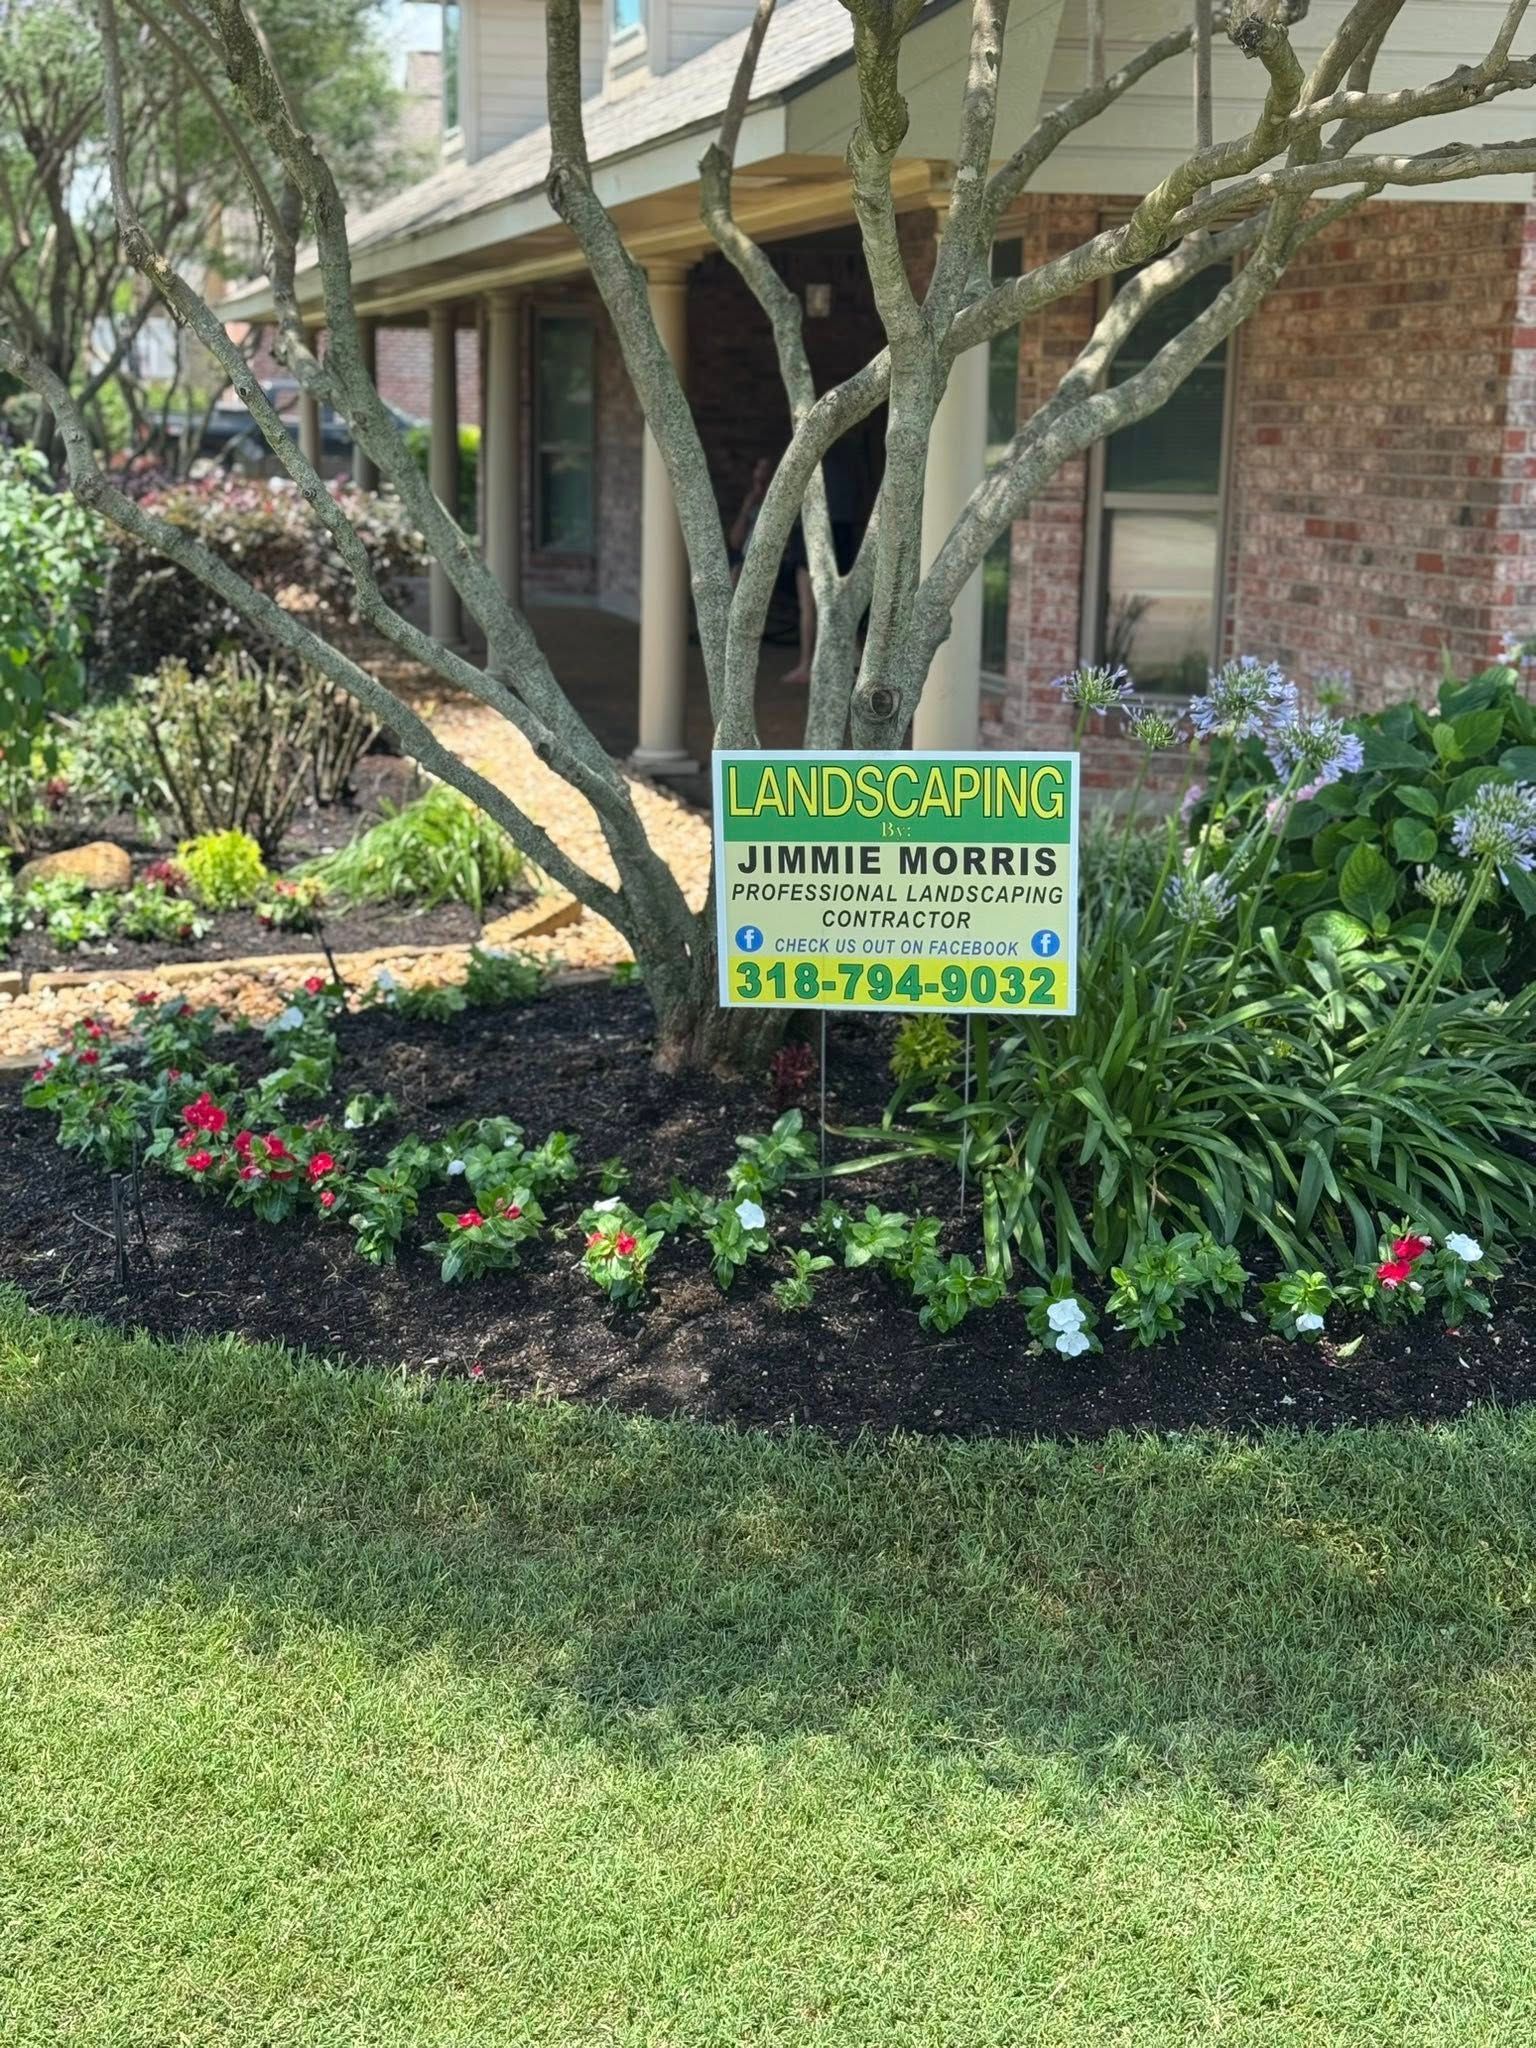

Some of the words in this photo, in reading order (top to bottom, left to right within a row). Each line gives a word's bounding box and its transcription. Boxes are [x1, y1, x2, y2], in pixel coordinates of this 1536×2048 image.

[727, 765, 1065, 819] LANDSCAPING
[881, 821, 912, 840] By:
[737, 845, 881, 875] JIMMIE
[900, 846, 1057, 877] MORRIS
[732, 883, 898, 902] PROFESSIONAL
[907, 884, 1063, 904] LANDSCAPING
[822, 910, 971, 929] CONTRACTOR
[775, 938, 829, 953] CHECK
[835, 939, 856, 954] US
[863, 939, 895, 955] OUT
[900, 940, 923, 955] ON
[929, 940, 1019, 956] FACEBOOK
[736, 961, 1056, 1005] 318-794-9032
